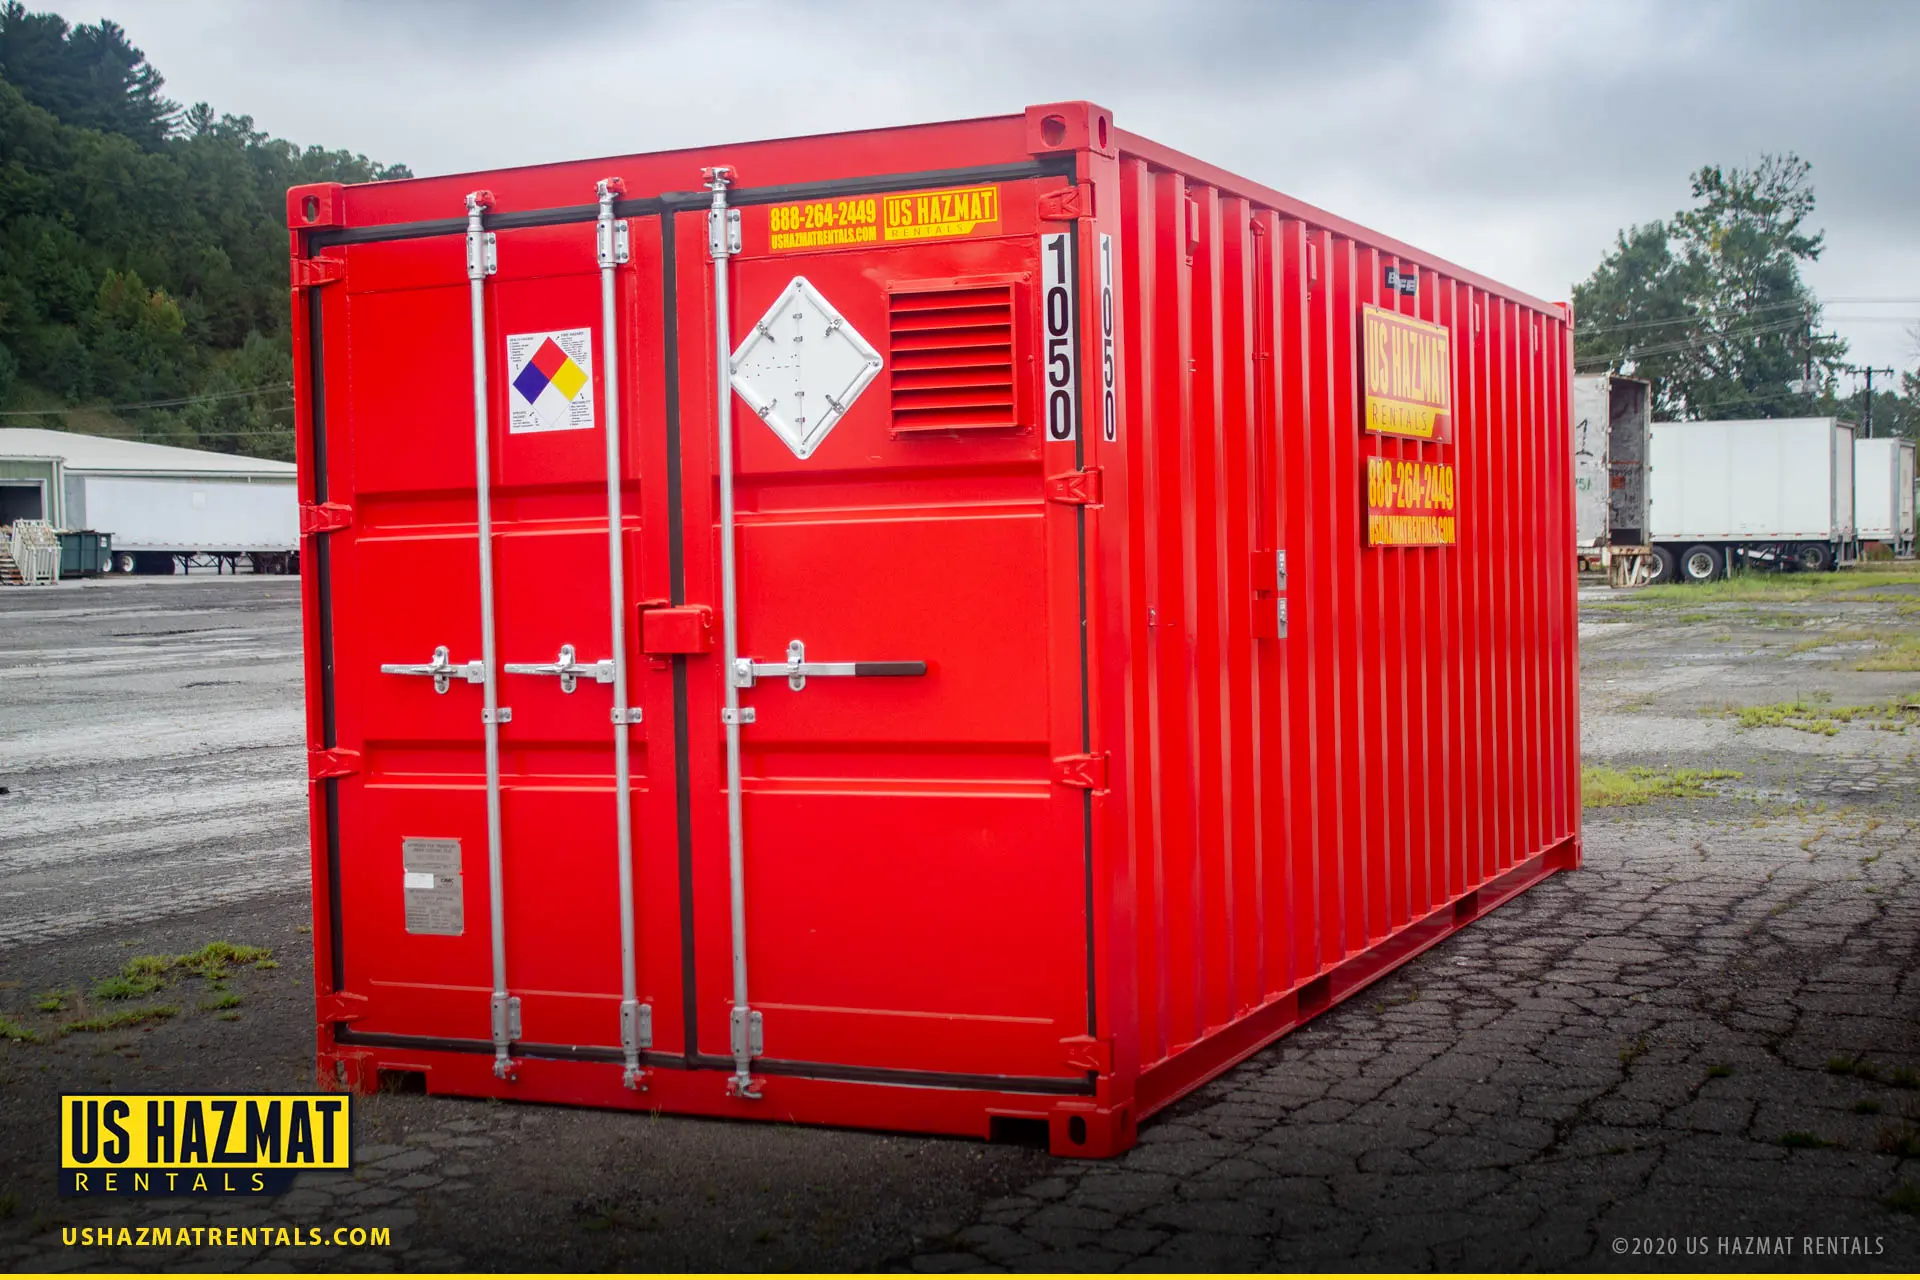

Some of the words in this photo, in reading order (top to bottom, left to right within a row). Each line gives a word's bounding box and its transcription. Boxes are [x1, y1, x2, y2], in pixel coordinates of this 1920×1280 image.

[770, 199, 876, 232] 888-264-2449
[889, 199, 912, 226] US
[918, 191, 992, 225] HAZMAT
[771, 226, 877, 250] USHAZMATRENTALS.COM
[891, 224, 964, 237] RENTALS
[1047, 234, 1072, 440] 1050
[1103, 236, 1115, 440] 1050
[1369, 319, 1388, 394] US
[1392, 326, 1446, 405] HAZMAT
[1372, 402, 1428, 431] RENTALS
[1369, 459, 1454, 510] 888-264-2449
[1369, 515, 1456, 545] USHAZMATRENTALS.COM
